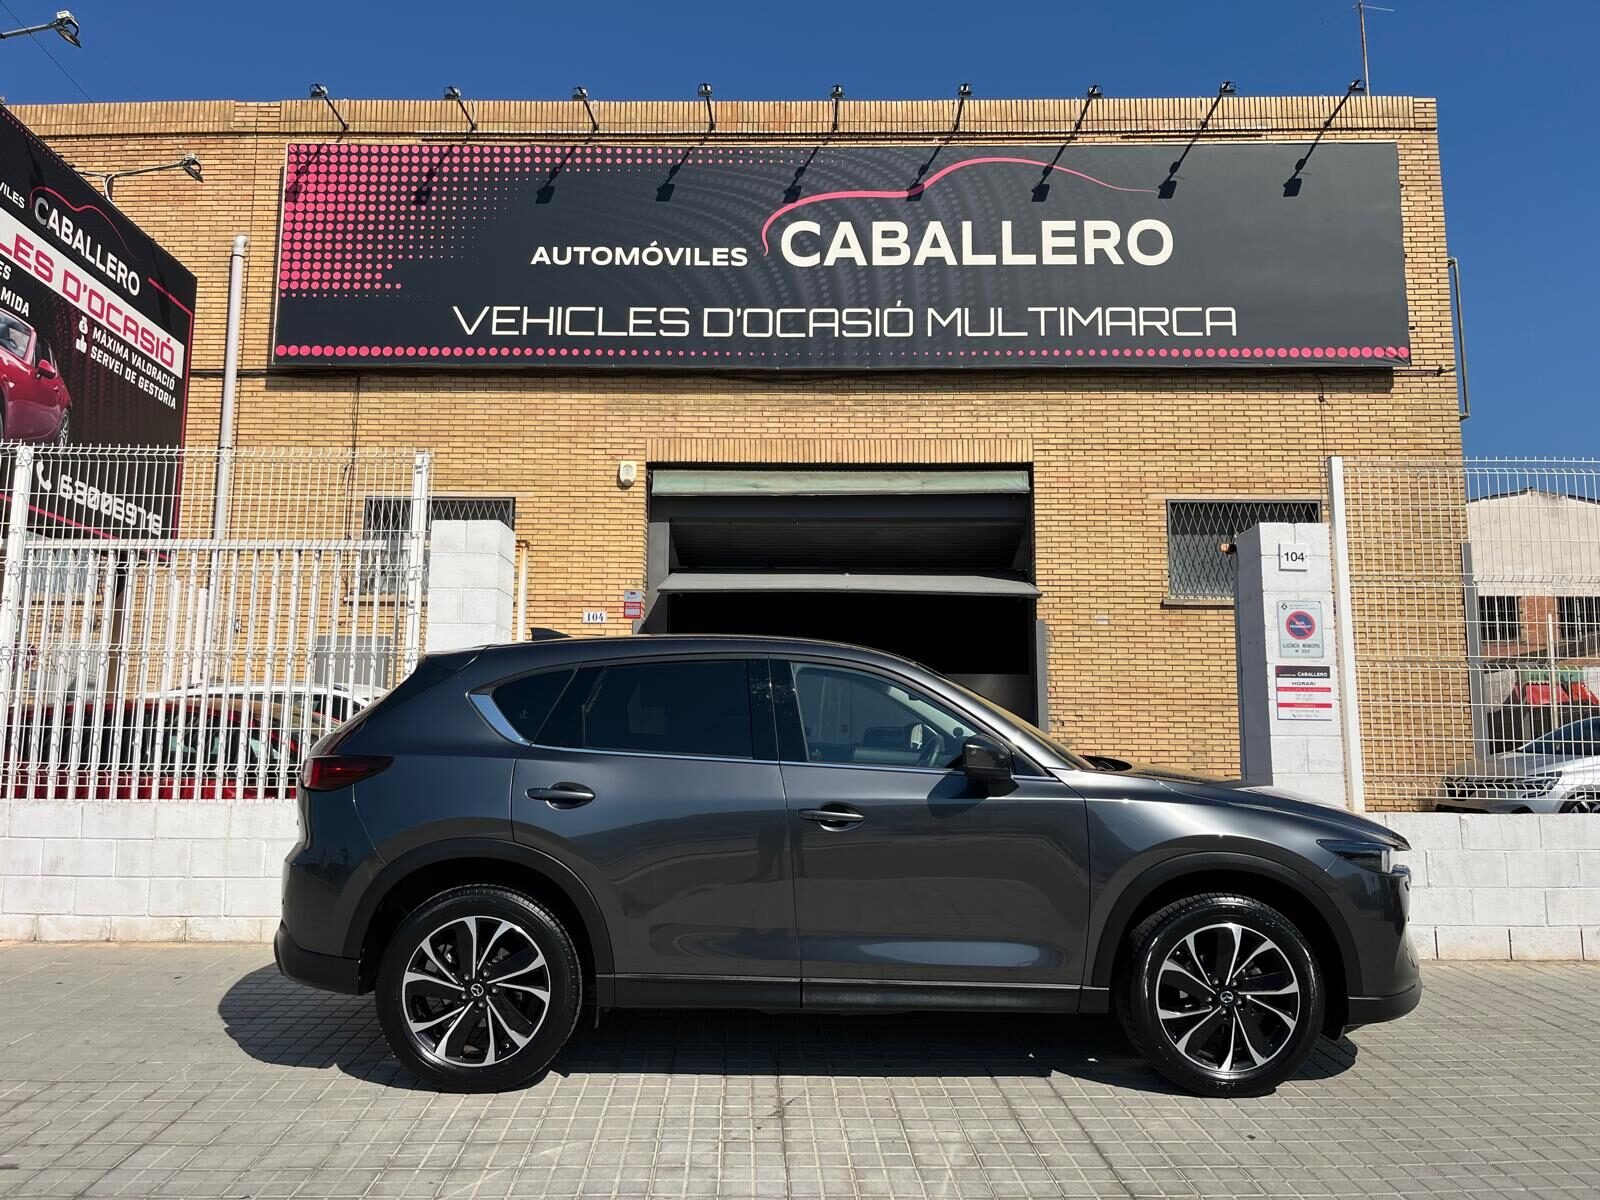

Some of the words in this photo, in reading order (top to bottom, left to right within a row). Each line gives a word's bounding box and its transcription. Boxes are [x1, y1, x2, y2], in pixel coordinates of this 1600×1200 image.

[34, 197, 140, 296] CABALLERO
[531, 241, 748, 267] AUTOMÓVILES
[780, 219, 1174, 267] CABALLERO
[0, 286, 30, 318] MIDA
[62, 269, 175, 369] D'OCASIÓ
[453, 306, 690, 336] VEHICLES
[703, 301, 914, 338] D'OCASIÓ
[927, 306, 1237, 337] MULTIMARCA
[90, 346, 123, 376] SERVEI
[125, 368, 137, 384] DE
[138, 375, 176, 410] GESTORIA
[92, 326, 129, 361] MÀXIMA
[131, 352, 175, 390] VALORACIÓ
[1284, 552, 1305, 562] 104
[587, 612, 604, 621] 104
